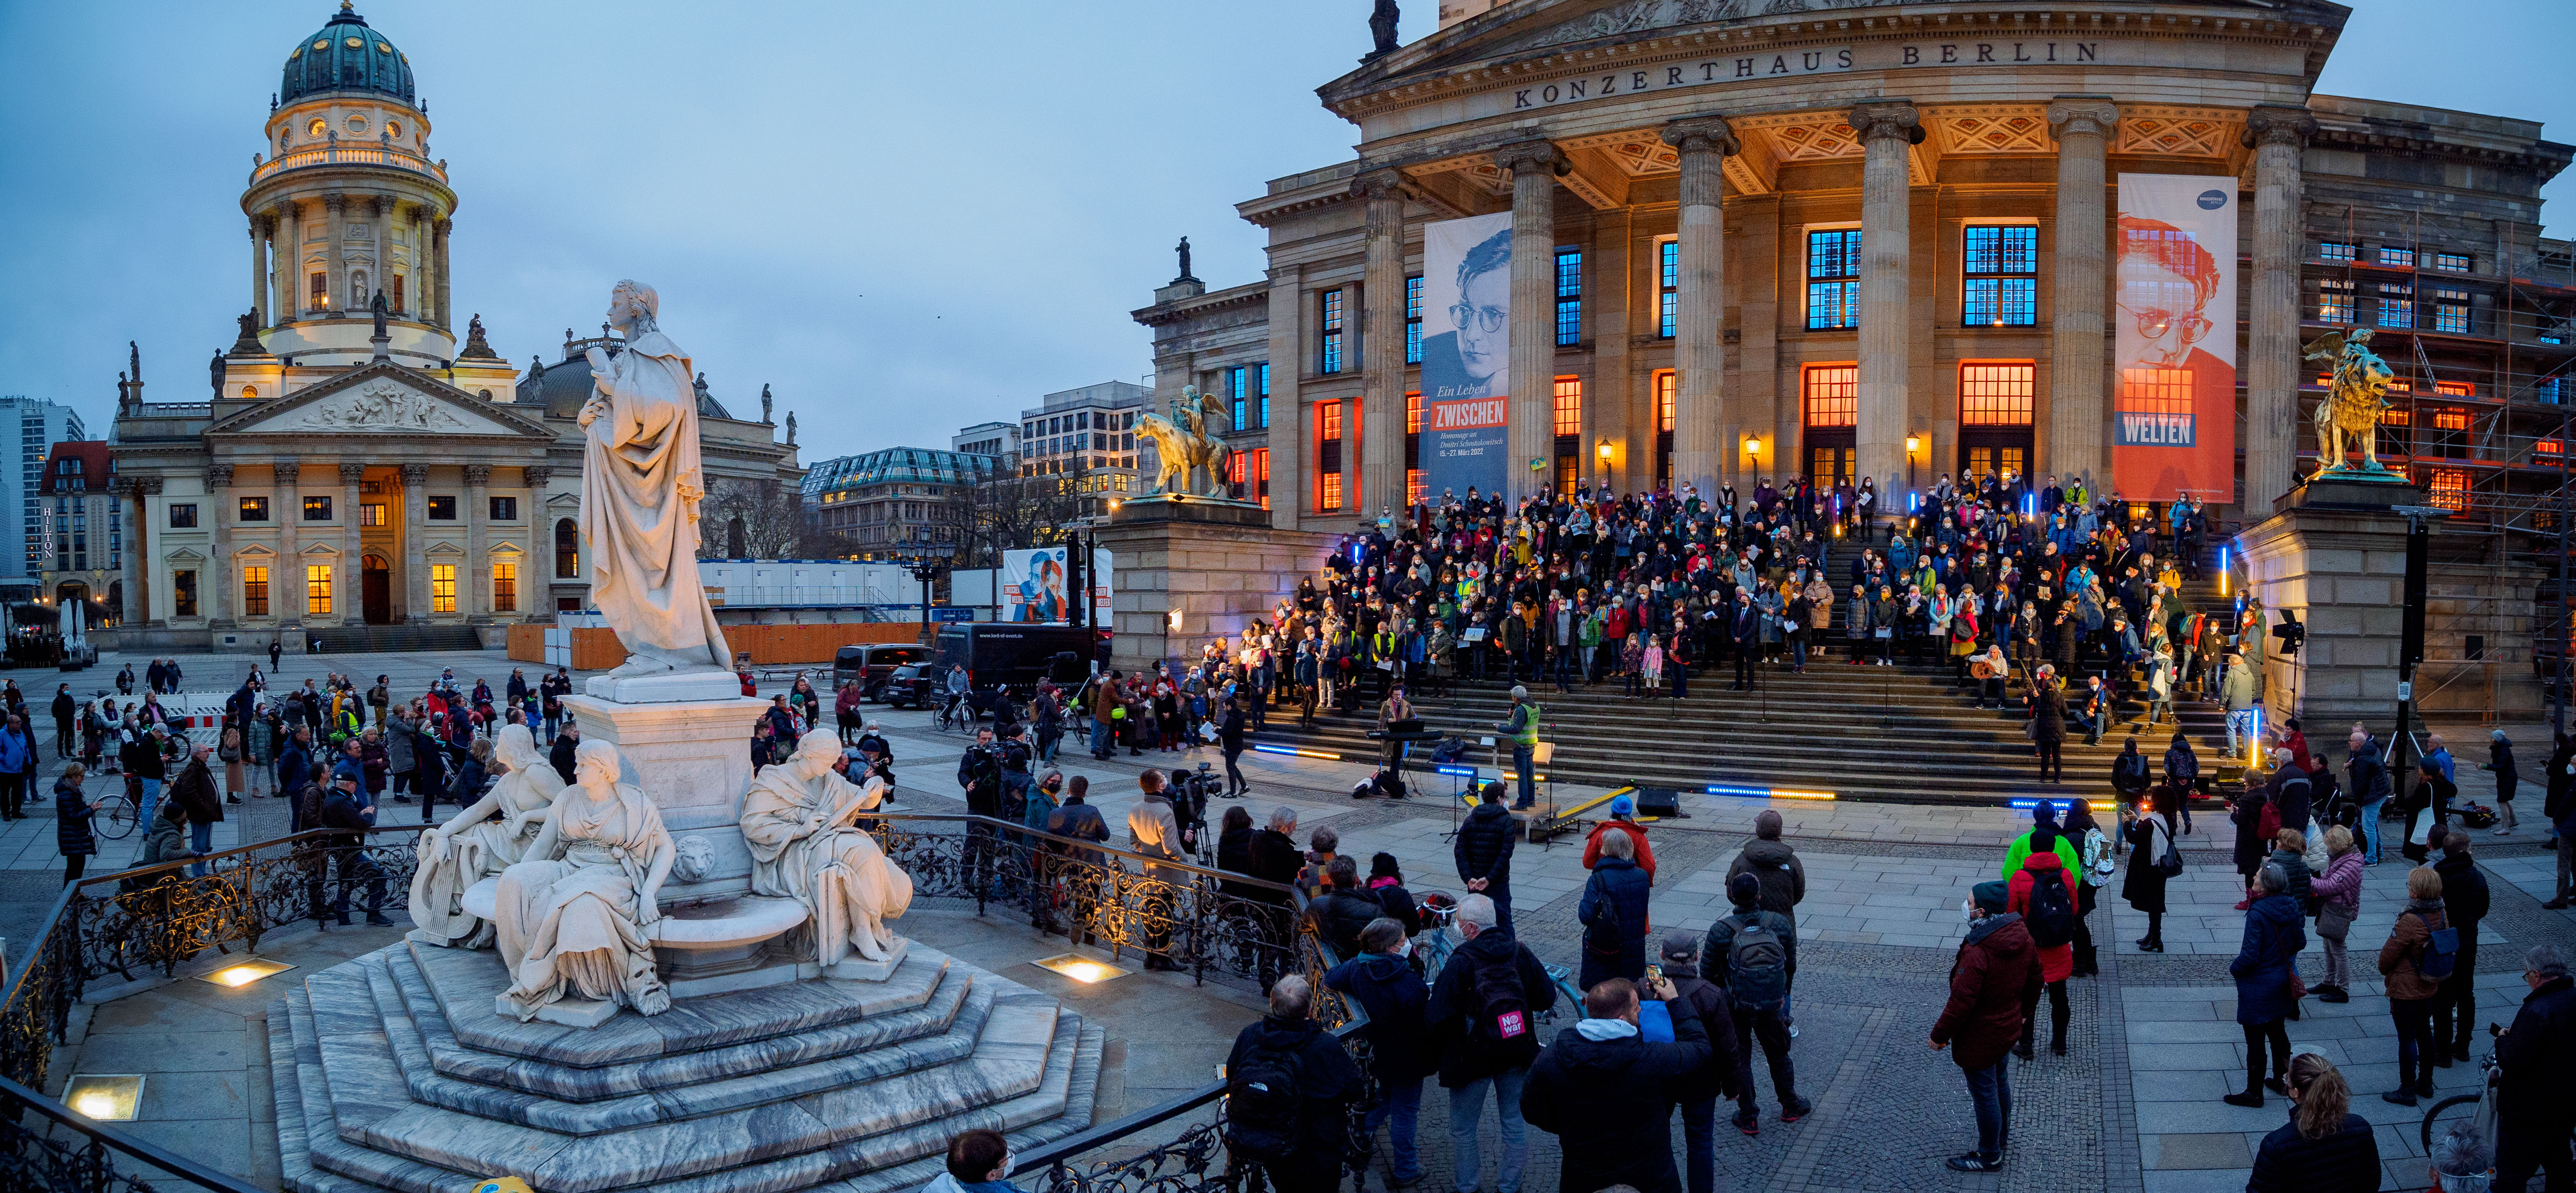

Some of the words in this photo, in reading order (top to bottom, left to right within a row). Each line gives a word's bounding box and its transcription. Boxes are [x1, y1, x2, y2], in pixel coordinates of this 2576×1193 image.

[1514, 50, 1852, 108] KONZERTHAUS
[1902, 43, 2097, 65] BERLIN
[1437, 386, 1454, 397] Ein
[1457, 383, 1486, 395] Leben
[1436, 400, 1504, 427] ZWISCHEN
[1459, 437, 1503, 447] Schostakowitsch
[2124, 416, 2190, 443] WELTEN
[44, 507, 53, 558] HILTON
[1504, 1023, 1521, 1033] war
